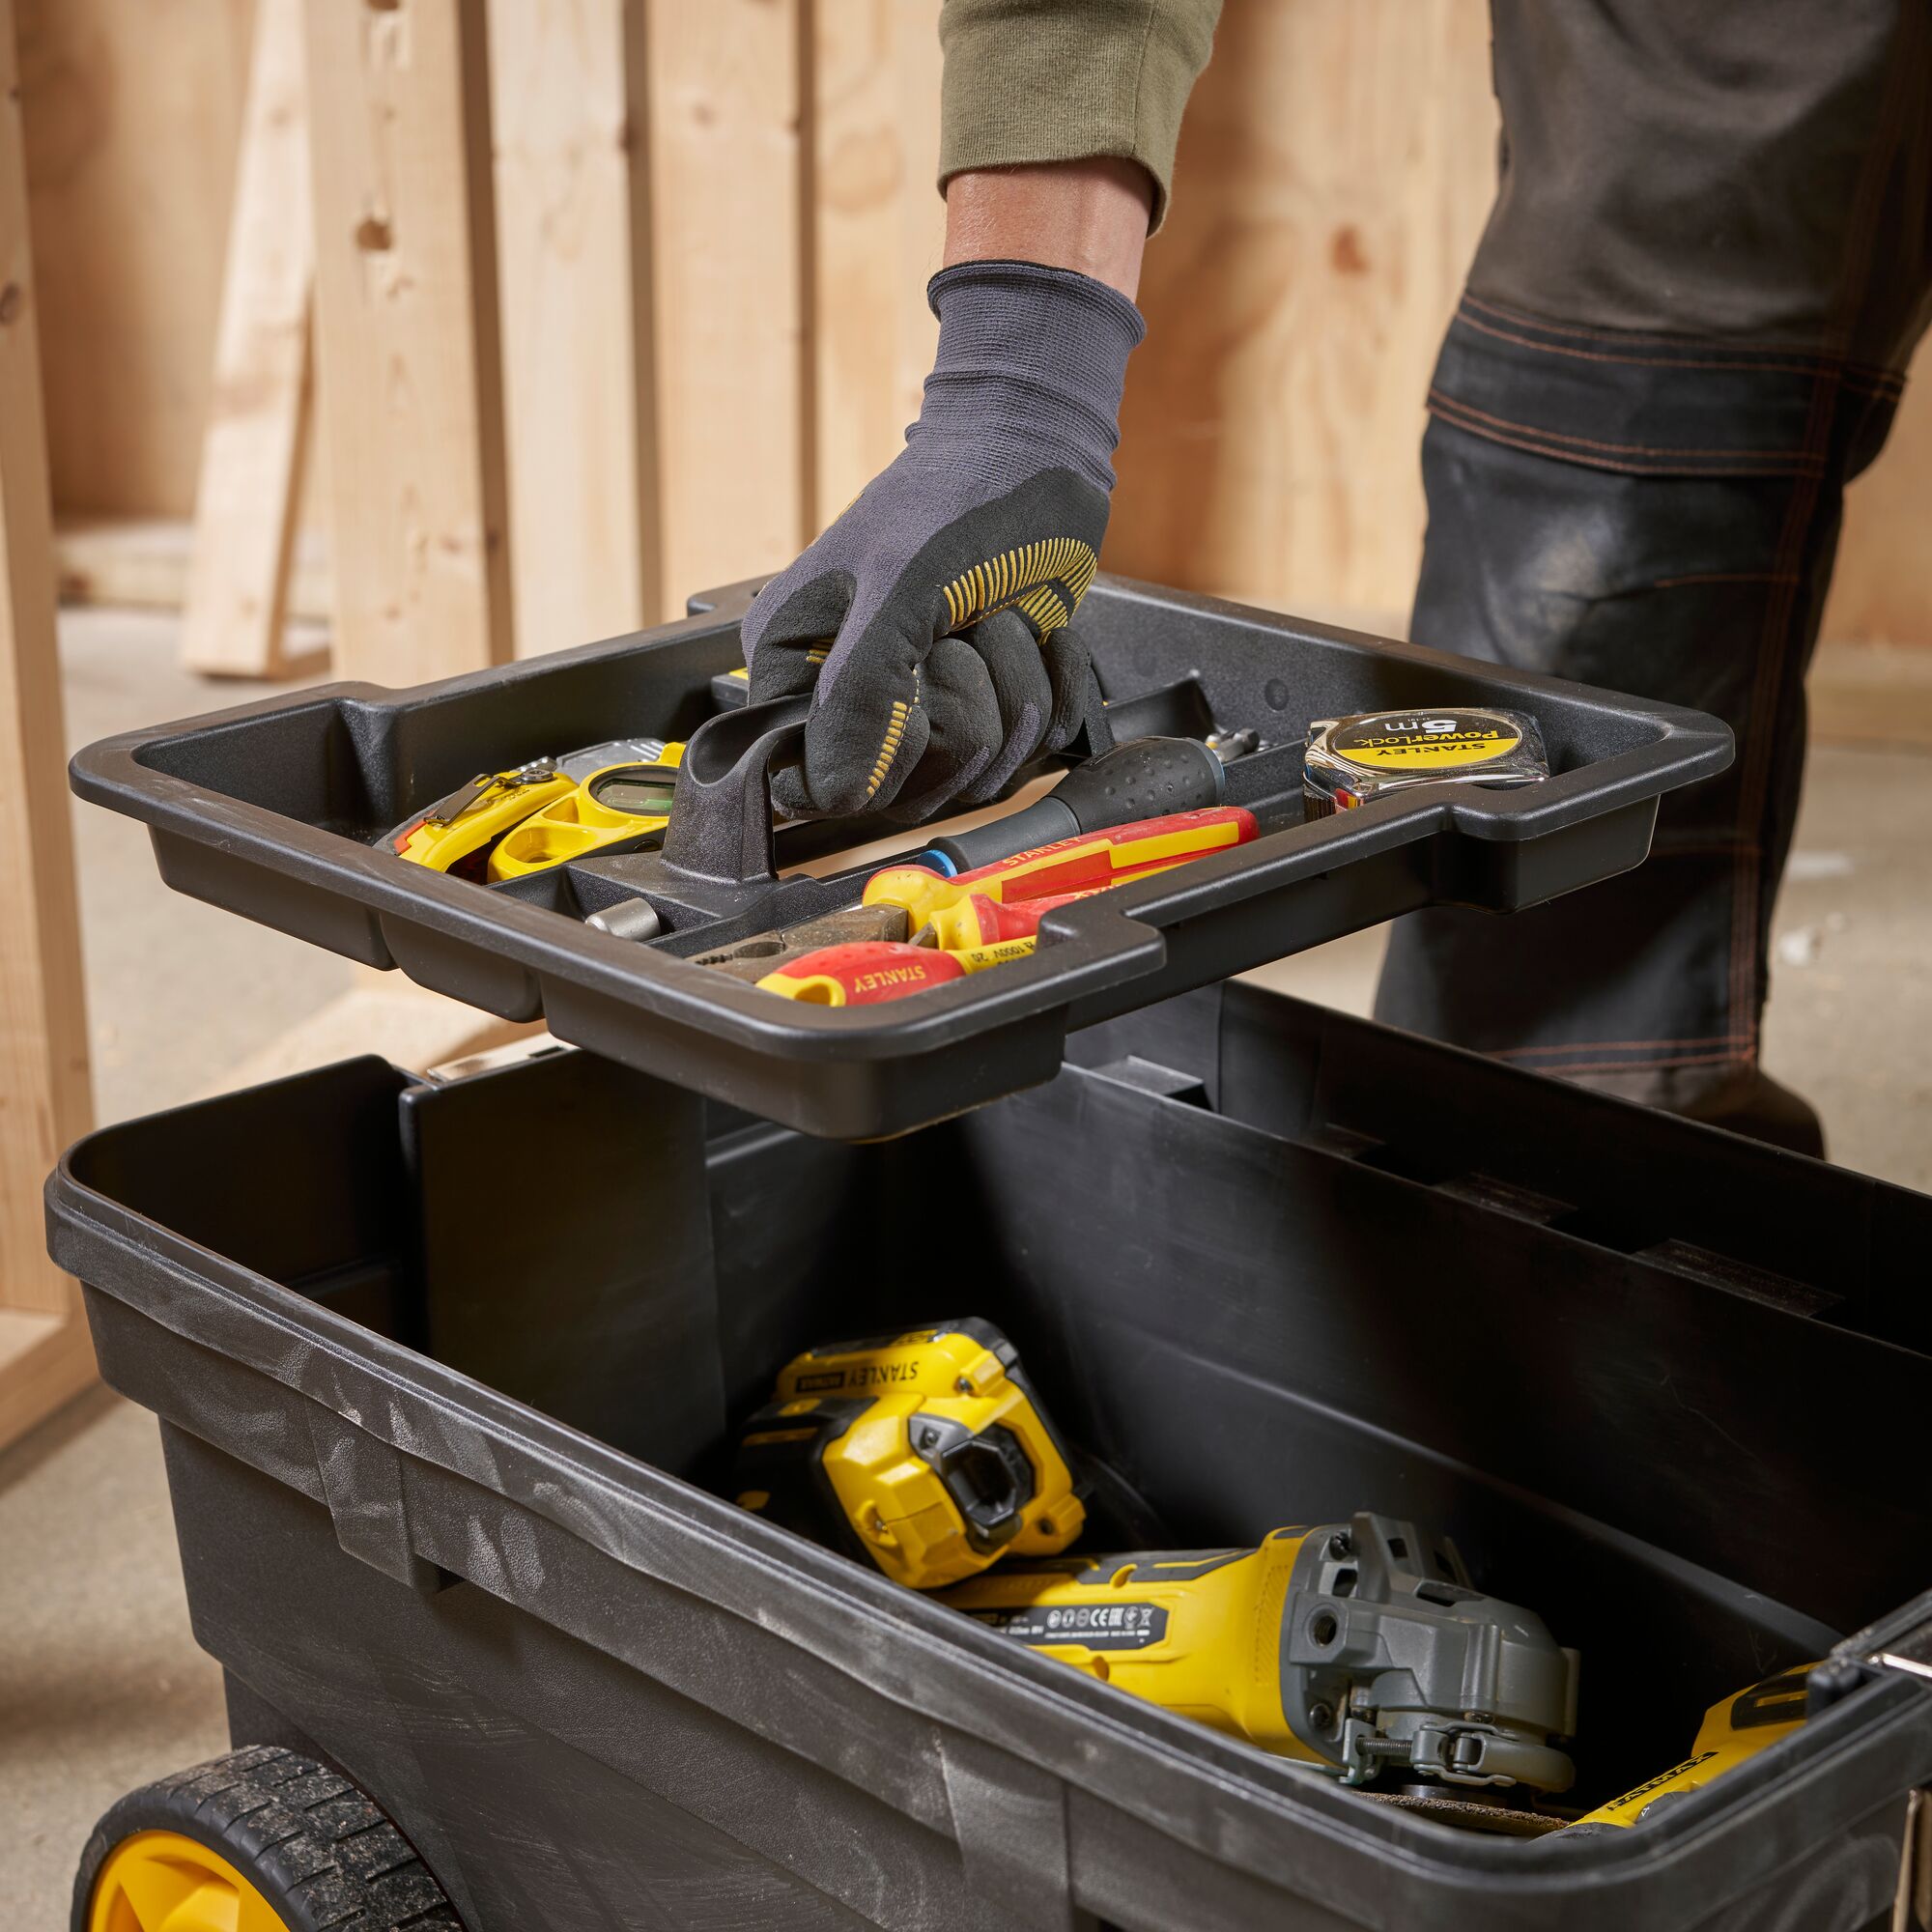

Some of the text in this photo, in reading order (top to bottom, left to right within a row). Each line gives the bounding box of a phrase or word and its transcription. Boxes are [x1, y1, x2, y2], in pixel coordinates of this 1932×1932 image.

[1384, 719, 1458, 734] 5m
[1360, 730, 1499, 748] PowerLock
[1377, 743, 1486, 756] STANLEY
[1003, 837, 1082, 867] STANLEY
[854, 965, 926, 993] STANLEY
[847, 1360, 920, 1388] STANLEY
